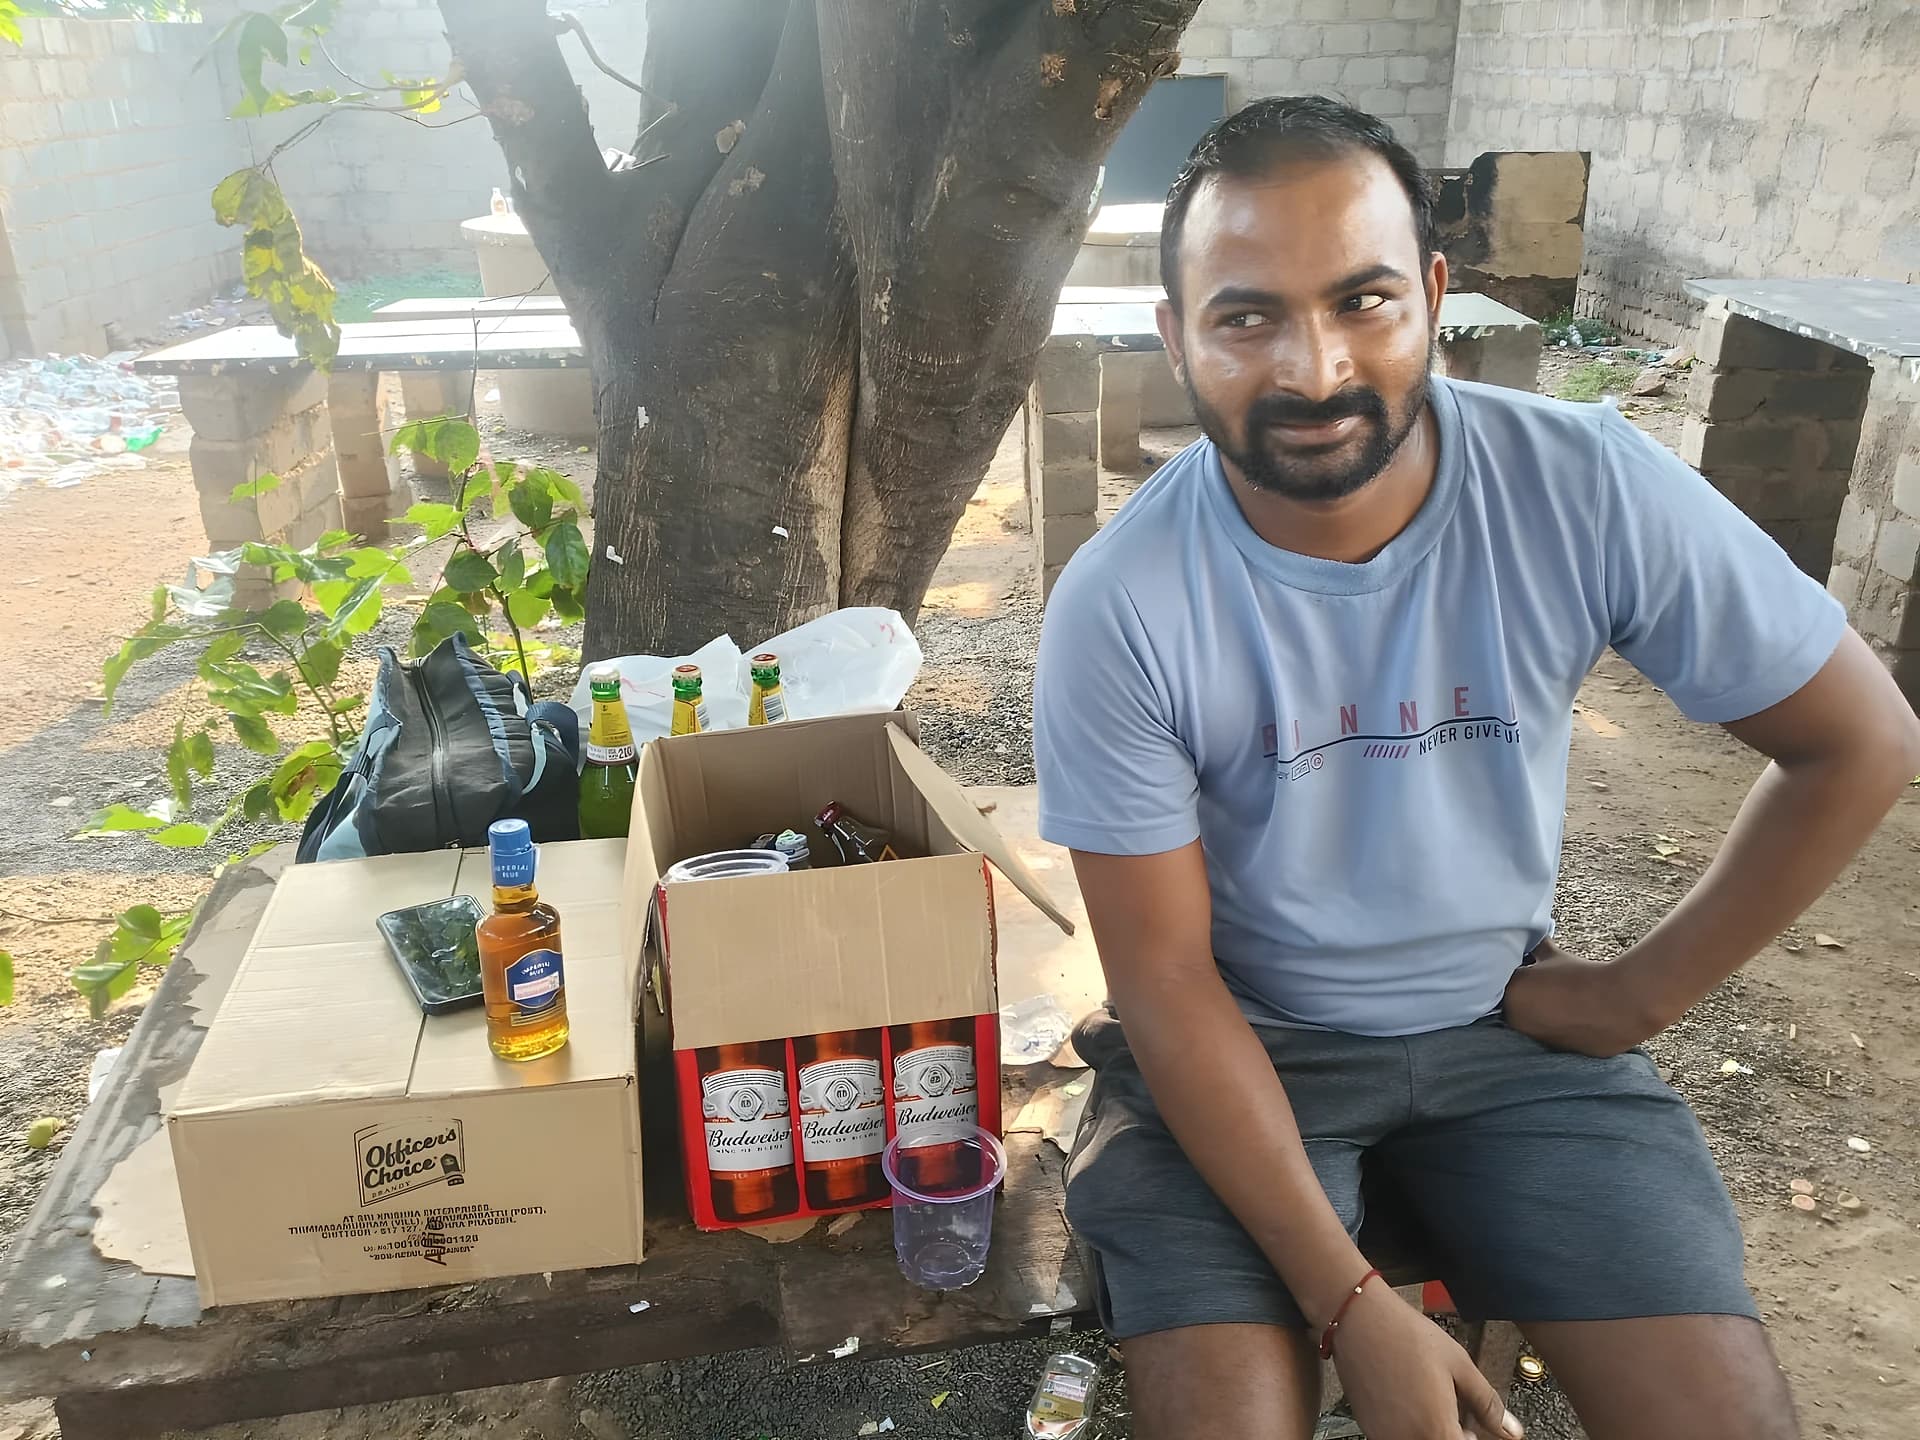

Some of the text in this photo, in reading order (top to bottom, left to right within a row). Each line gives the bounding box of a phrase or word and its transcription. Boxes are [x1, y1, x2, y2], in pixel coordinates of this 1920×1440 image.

[1419, 727, 1457, 756] NEVER
[1464, 724, 1501, 740] GIVE
[366, 1127, 457, 1168] Officer's
[708, 1128, 790, 1148] Budweiser
[364, 1159, 436, 1189] Choice
